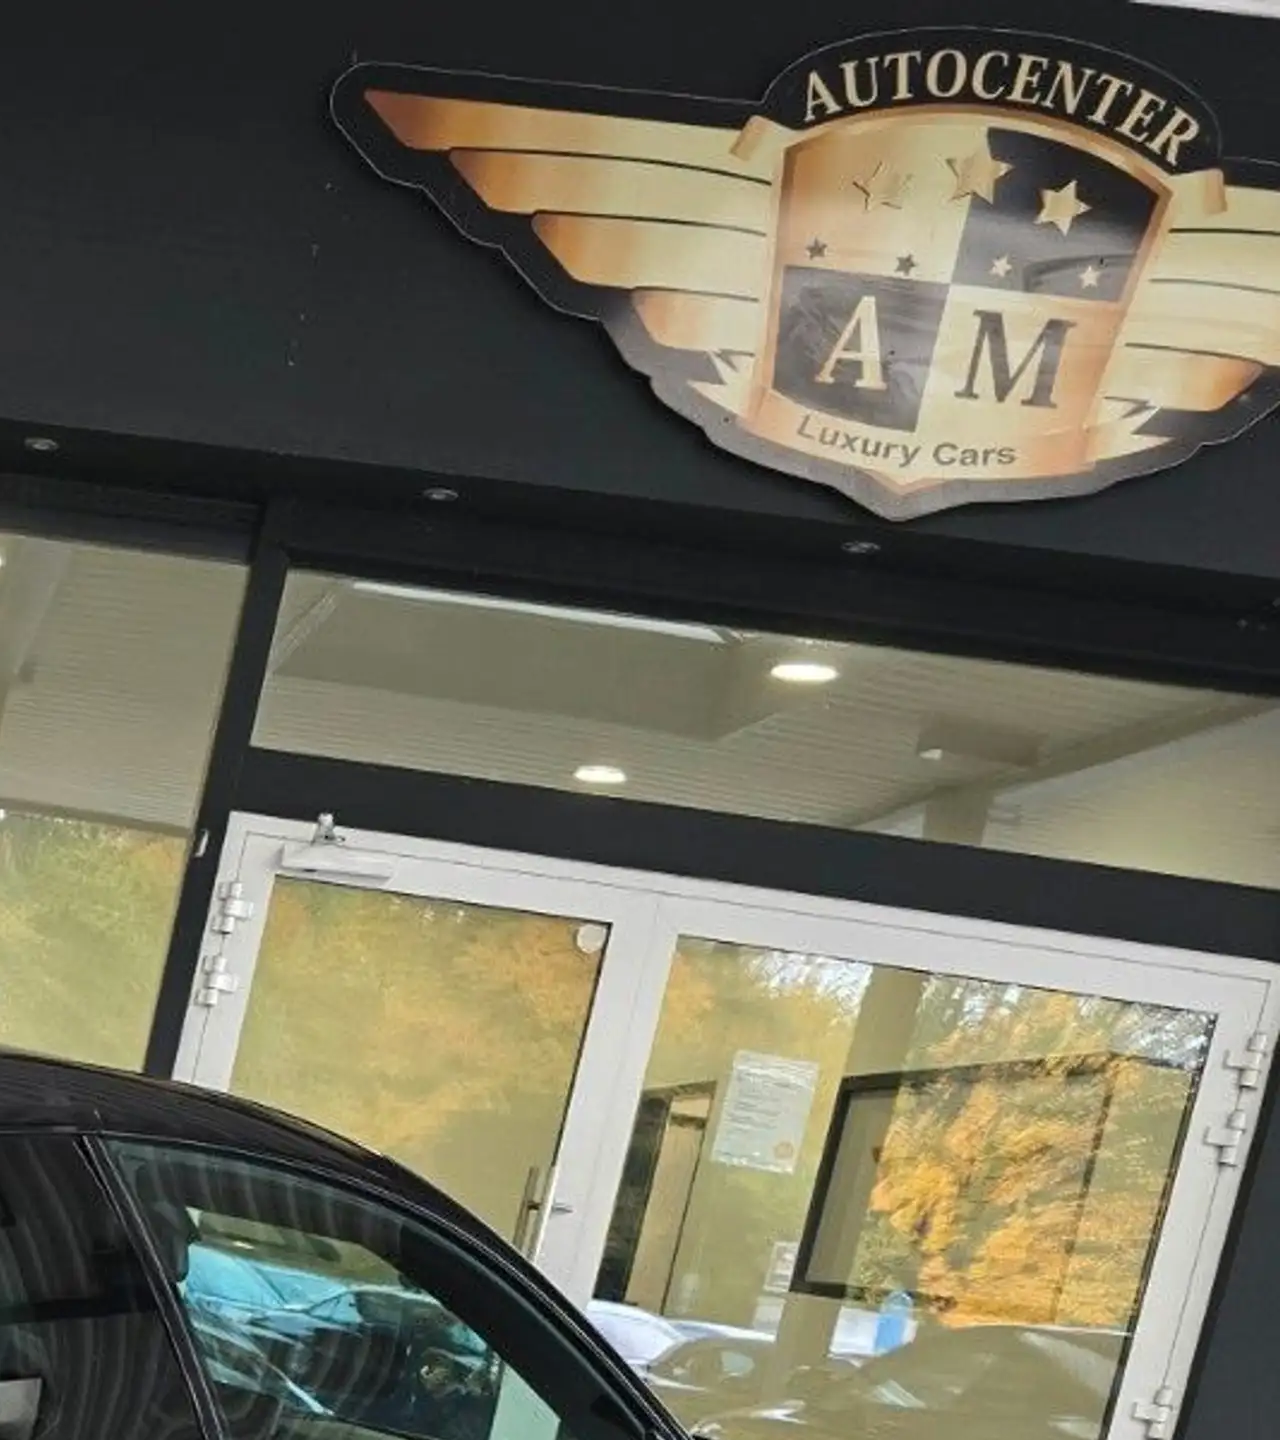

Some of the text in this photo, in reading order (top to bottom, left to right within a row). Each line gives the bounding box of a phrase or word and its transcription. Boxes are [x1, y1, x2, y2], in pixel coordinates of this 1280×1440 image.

[802, 49, 1200, 166] AUTOCENTER
[814, 295, 1078, 408] A M
[796, 414, 1017, 468] Luxury Cars
